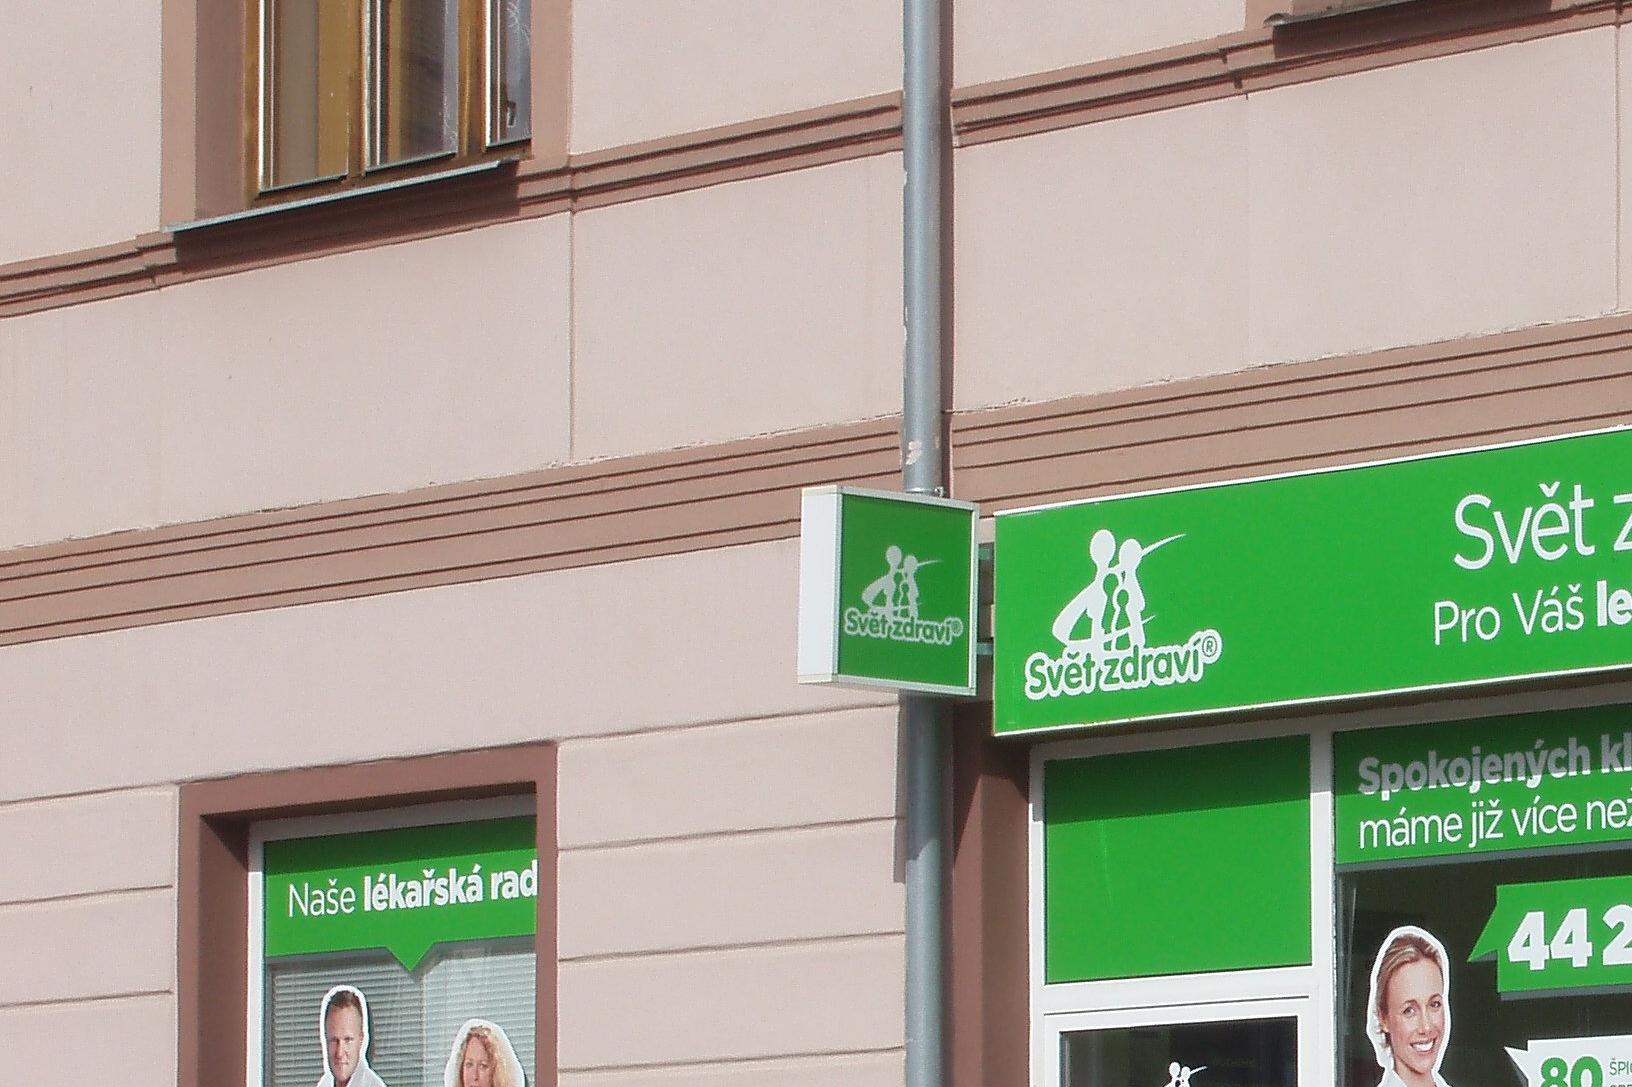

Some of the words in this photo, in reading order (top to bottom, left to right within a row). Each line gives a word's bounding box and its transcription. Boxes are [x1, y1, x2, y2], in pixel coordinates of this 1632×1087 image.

[1454, 481, 1595, 570] Svět
[845, 609, 890, 636] Svět
[1434, 601, 1500, 645] Pro
[1513, 584, 1584, 635] Váš
[1028, 648, 1096, 694] Svět
[1358, 737, 1590, 800] Spokojených
[1359, 807, 1462, 849] máme
[1470, 799, 1503, 848] již
[1513, 796, 1577, 837] více
[289, 879, 355, 917] Naše
[364, 864, 483, 911] lékařská
[1507, 909, 1593, 970] 44
